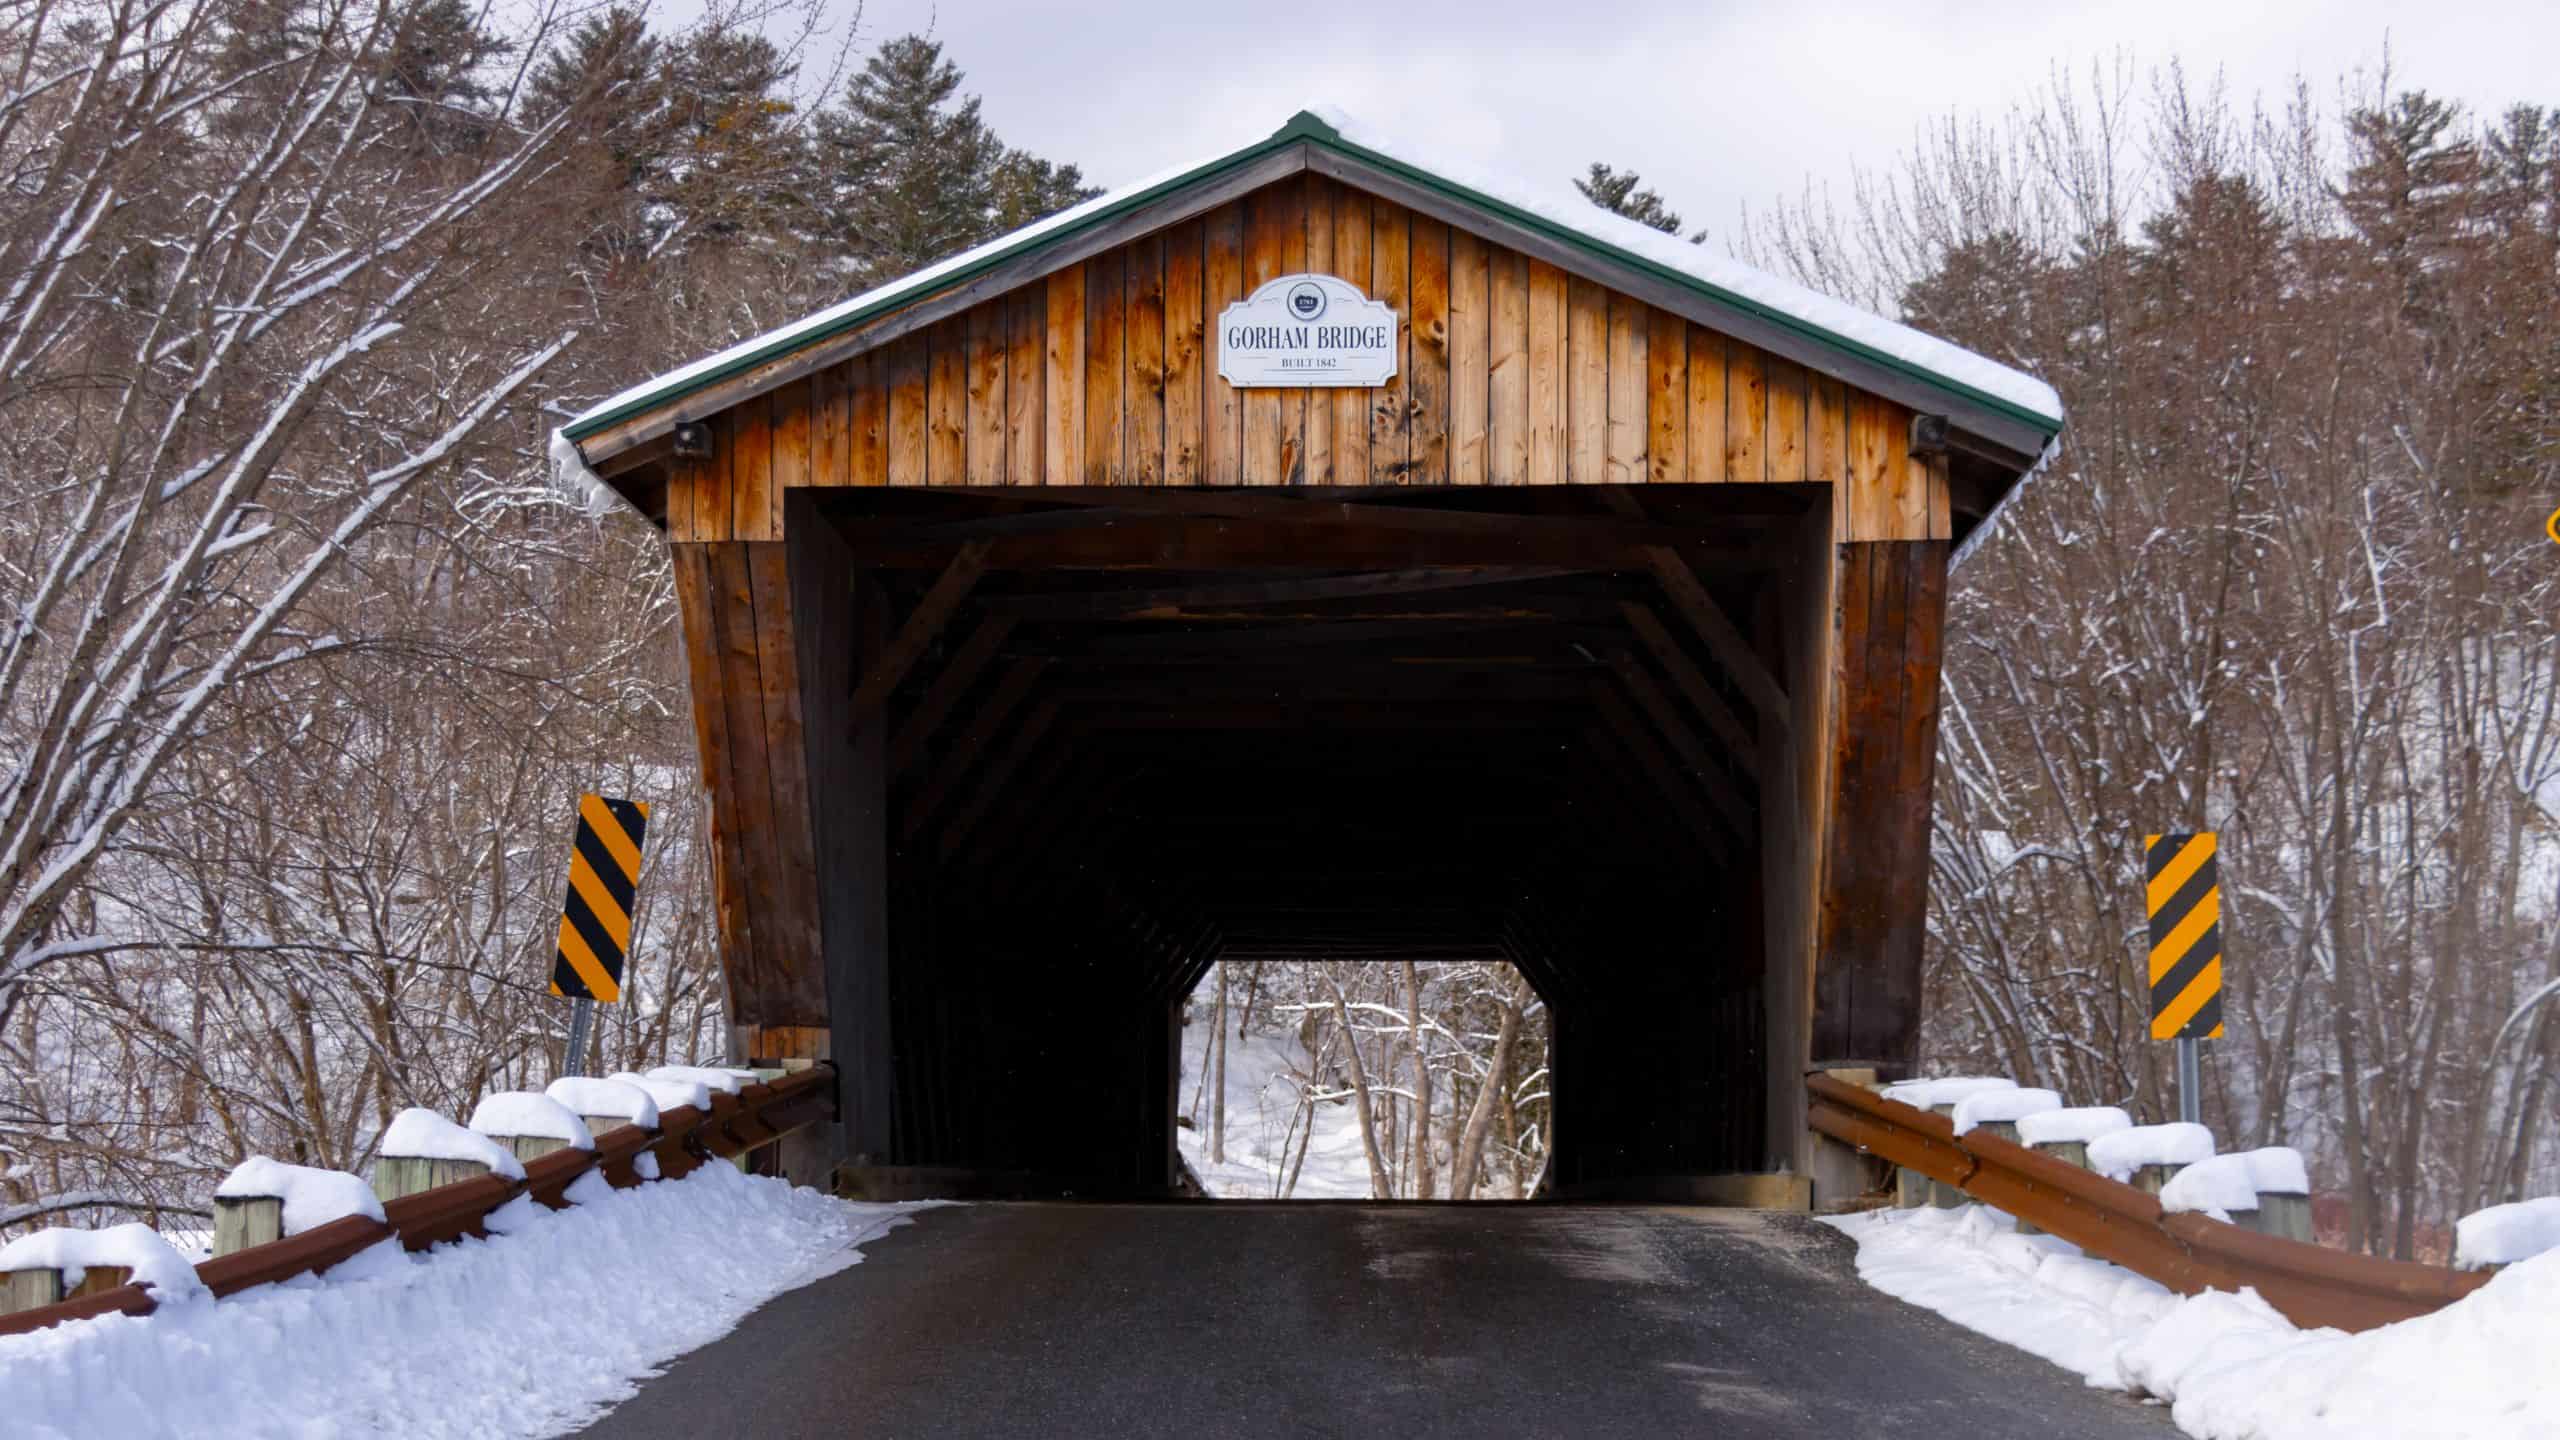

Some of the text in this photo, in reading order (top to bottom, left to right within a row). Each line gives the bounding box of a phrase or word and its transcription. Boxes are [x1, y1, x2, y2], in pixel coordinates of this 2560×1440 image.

[1228, 326, 1387, 349] GORHAM BRIDGE
[1281, 358, 1337, 368] BUILT 1842
